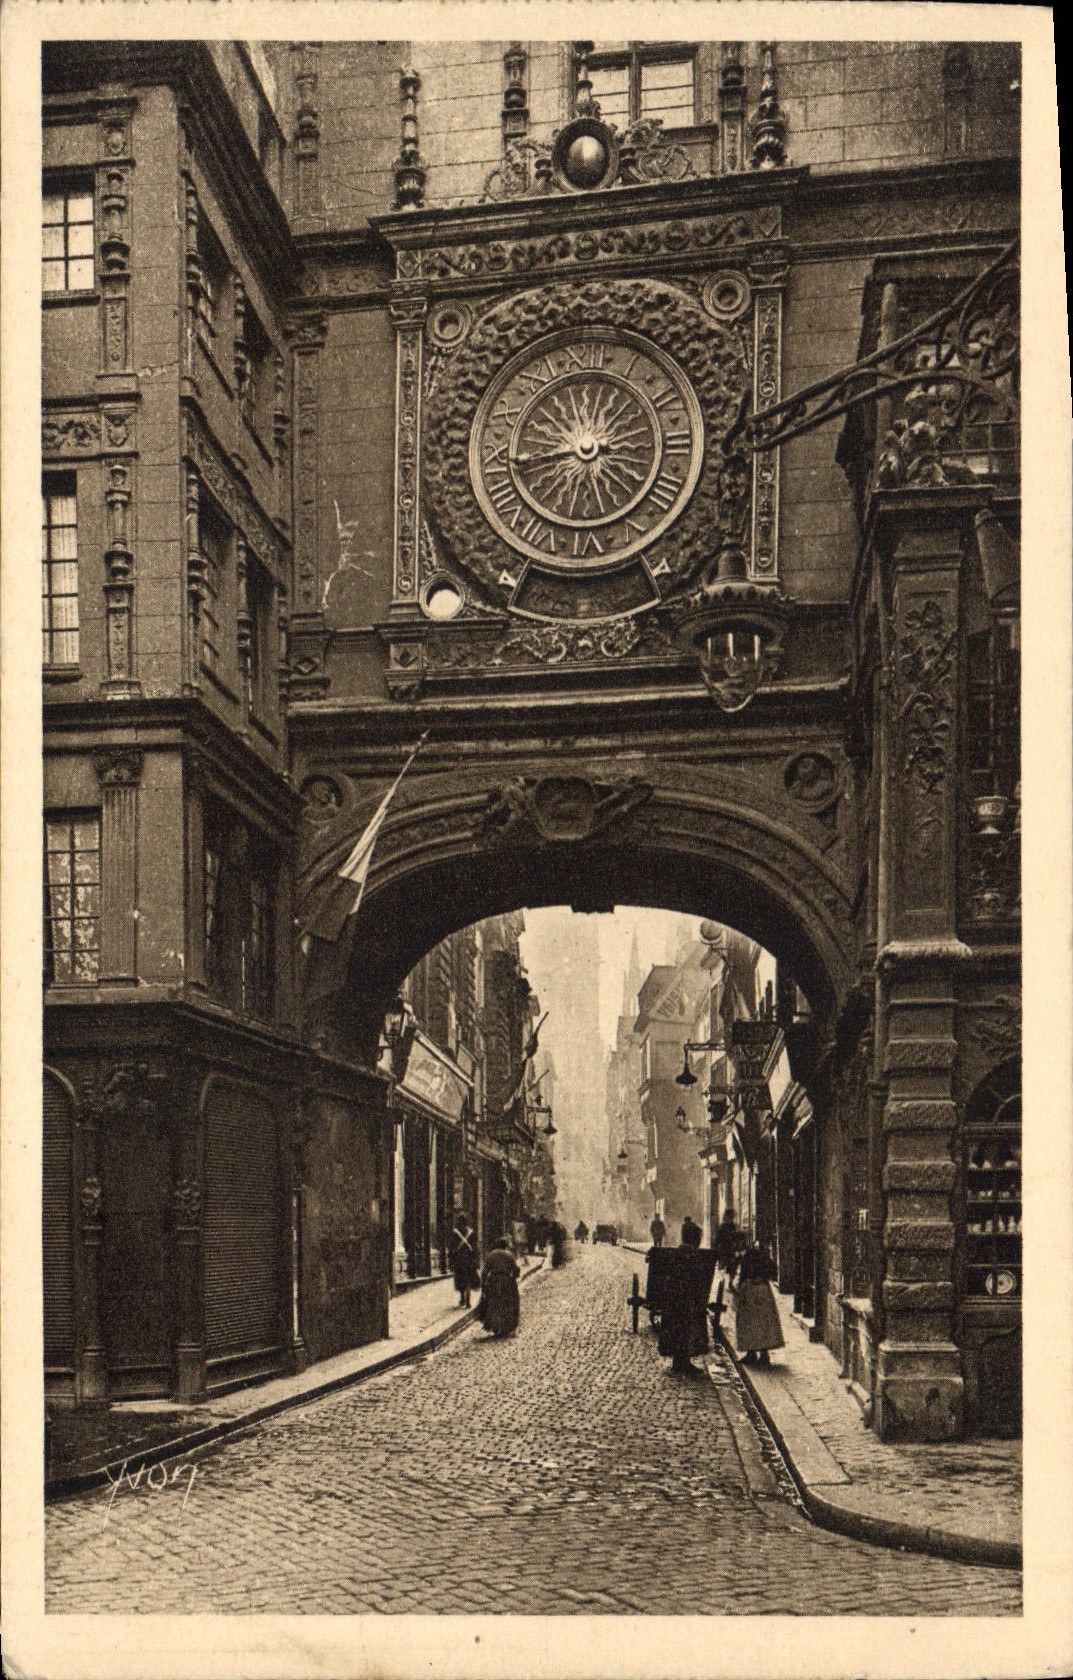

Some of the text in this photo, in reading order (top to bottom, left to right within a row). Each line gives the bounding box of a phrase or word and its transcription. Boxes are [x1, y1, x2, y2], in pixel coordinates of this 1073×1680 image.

[565, 344, 606, 373] XII
[623, 355, 639, 377] I
[520, 355, 557, 393] XI
[651, 385, 679, 409] II
[492, 399, 522, 426] X
[665, 430, 690, 454] III
[484, 444, 509, 474] IX
[489, 480, 522, 528] VIII
[650, 473, 682, 510] IIII
[521, 516, 556, 552] VII
[573, 531, 604, 555] VI
[625, 520, 647, 543] V
